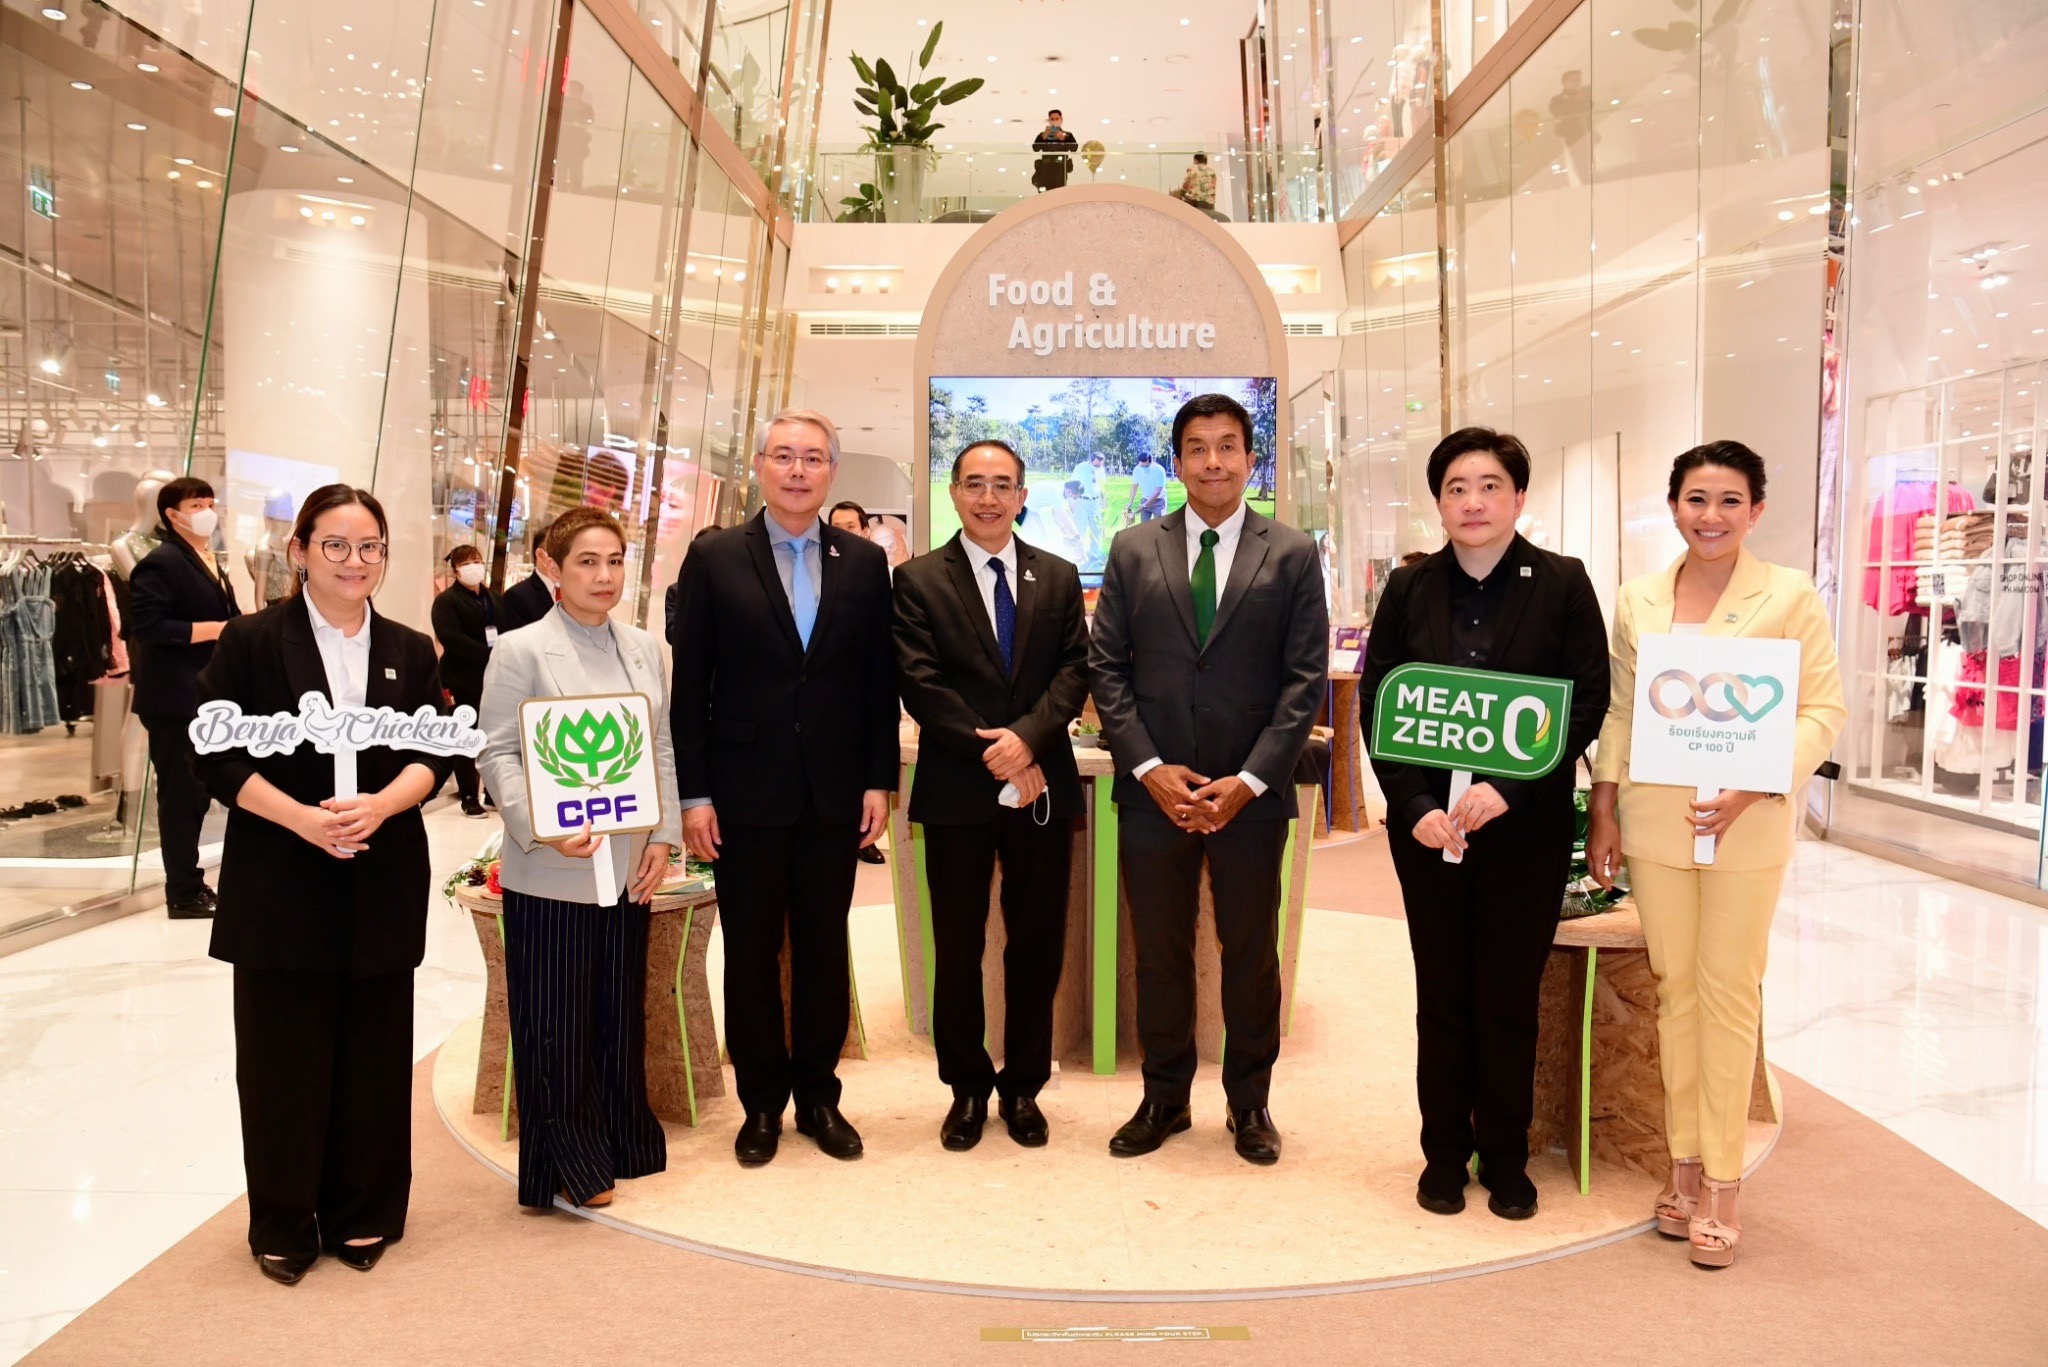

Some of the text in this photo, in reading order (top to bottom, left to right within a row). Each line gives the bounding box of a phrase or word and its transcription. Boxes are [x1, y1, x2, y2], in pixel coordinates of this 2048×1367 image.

[989, 271, 1117, 306] Food &
[1008, 314, 1216, 356] Agriculture
[2000, 574, 2017, 582] SHOP
[1396, 683, 1498, 720] MEAT
[196, 706, 461, 750] Benja Chicken
[1392, 716, 1495, 754] ZERO
[1668, 724, 1756, 741] ร้อยเรียงความดี
[1688, 741, 1734, 753] CP 100 ปี
[556, 794, 638, 828] CPF
